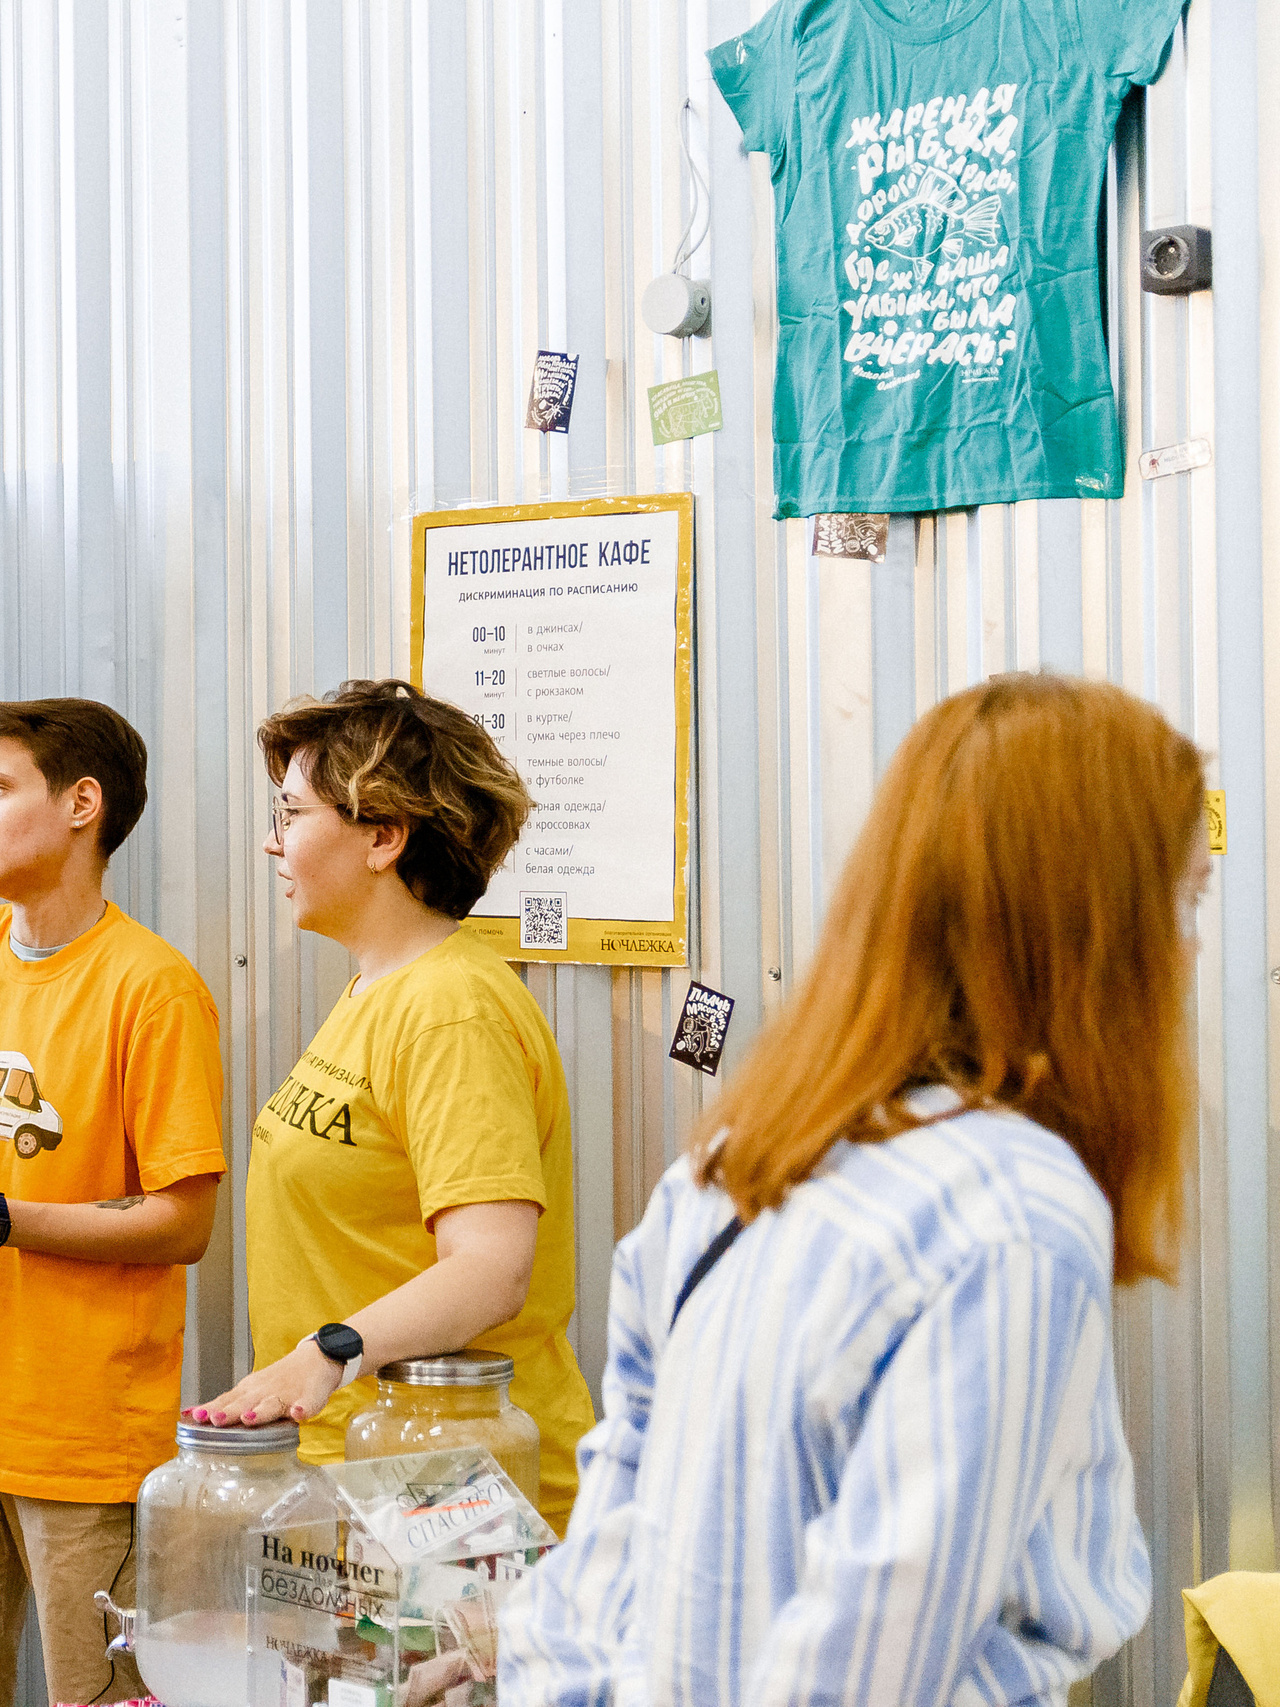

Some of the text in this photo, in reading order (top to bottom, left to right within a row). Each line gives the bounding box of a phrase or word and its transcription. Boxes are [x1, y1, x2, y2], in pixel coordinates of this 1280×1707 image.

[448, 539, 651, 576] НЕТОЛЕРАНТНОЕ КАФЕ
[458, 582, 639, 603] ДИСКРИМИНАЦИЯ ПО РАСПИСАНИЮ
[527, 621, 583, 635] в джинсах/
[483, 647, 506, 656] минут
[527, 643, 564, 652] в очках
[527, 665, 611, 679] светлые волосы/
[535, 687, 584, 700] рюкзаком
[527, 711, 573, 725] в куртке/
[527, 731, 620, 744] сумка через плечо
[527, 755, 607, 767] темные волосы/
[526, 774, 584, 788] в футболке
[564, 800, 606, 812] одежда/
[526, 821, 590, 832] в кроссовках
[525, 845, 573, 856] с часами/
[525, 863, 595, 876] белая одежда
[601, 939, 675, 953] НОЧЛЕЖКА
[262, 1534, 384, 1586] На ночлег
[261, 1568, 385, 1618] бездомных
